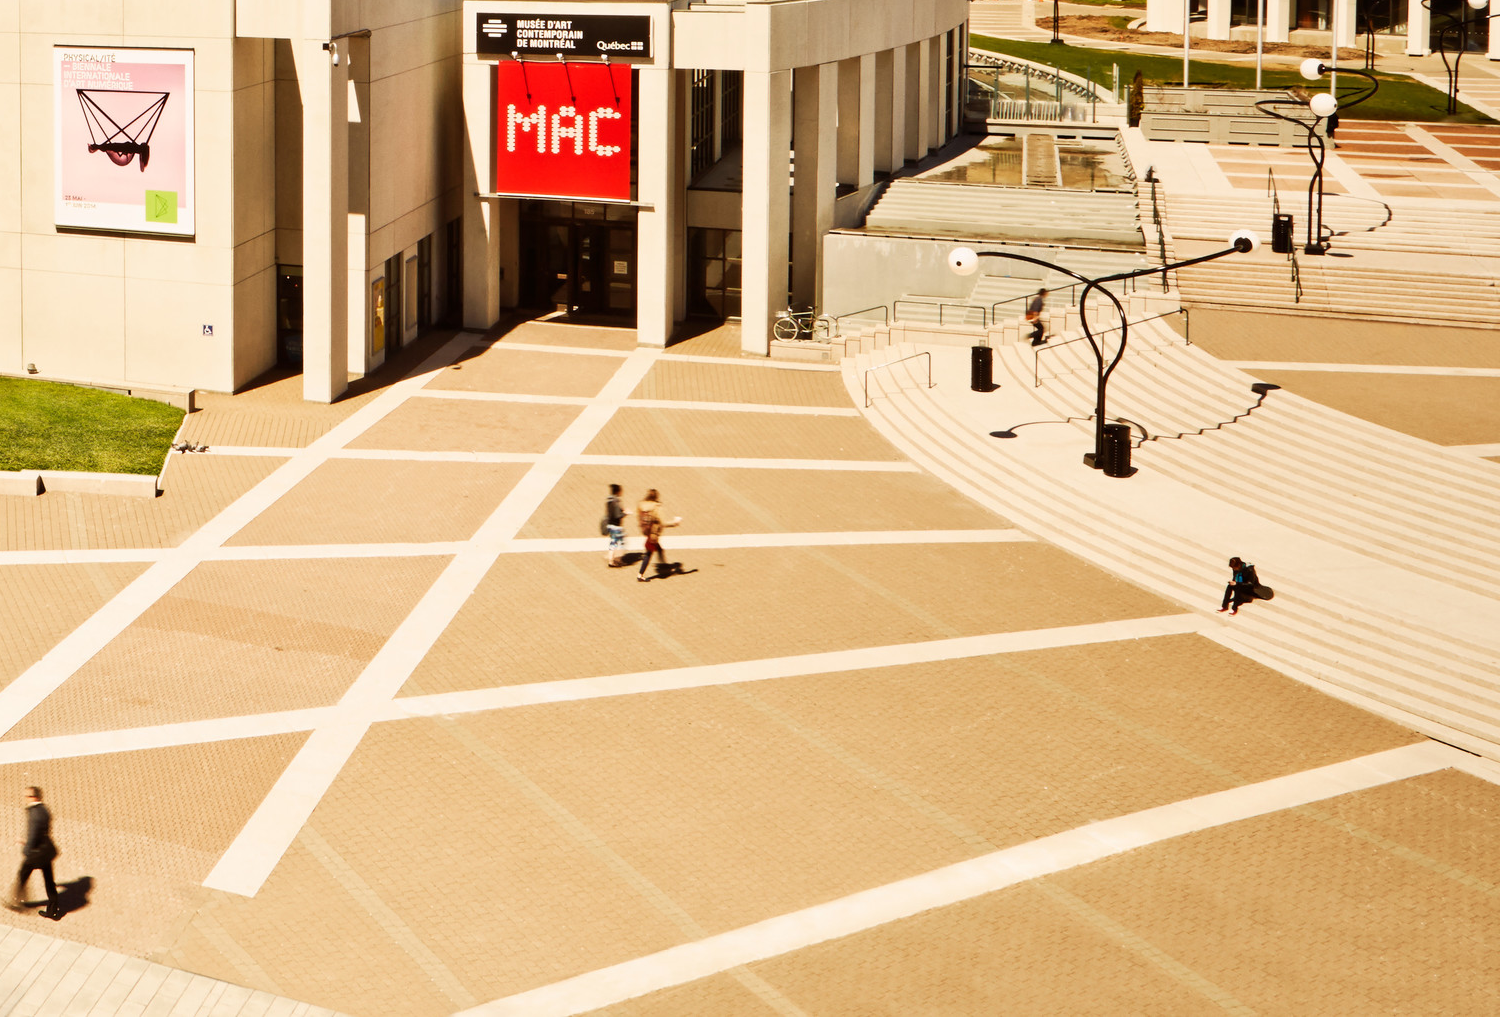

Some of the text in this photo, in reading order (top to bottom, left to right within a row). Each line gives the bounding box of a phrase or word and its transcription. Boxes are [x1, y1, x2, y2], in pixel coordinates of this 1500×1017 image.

[516, 18, 572, 29] MUSÉE D'ART
[516, 29, 583, 39] CONTEMPORAIN
[516, 38, 576, 49] DE MONTRÉAL
[596, 40, 631, 51] Québec
[72, 62, 112, 71] BIENNALE
[63, 71, 130, 81] INTERNATIONALE
[87, 79, 134, 90] NUMÉRIQUE
[507, 103, 621, 157] MAC
